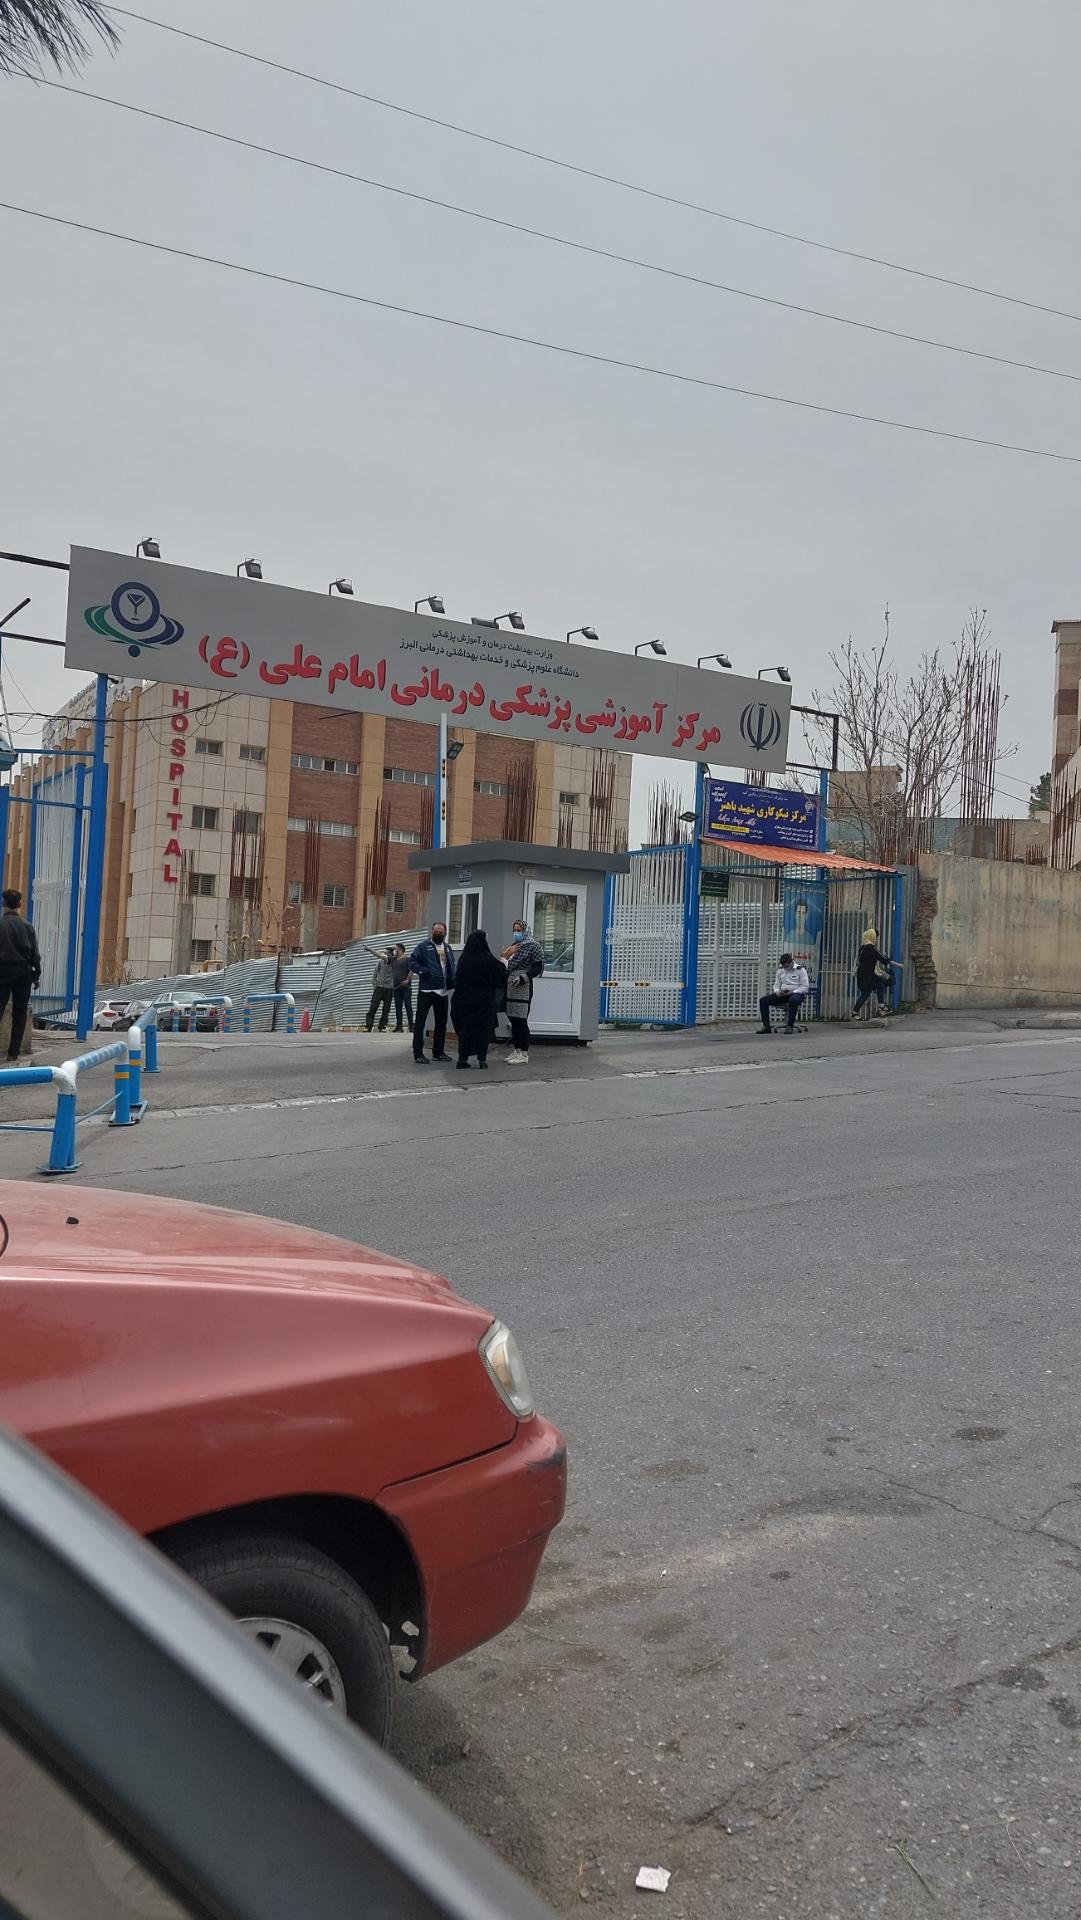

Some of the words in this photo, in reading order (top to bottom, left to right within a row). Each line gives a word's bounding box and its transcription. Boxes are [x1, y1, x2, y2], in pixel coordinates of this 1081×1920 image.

[432, 629, 456, 642] پزشکی
[457, 635, 481, 645] آموزش
[399, 638, 418, 649] البرز
[419, 643, 445, 654] درمانی
[487, 639, 507, 650] درمان
[508, 643, 534, 656] بهداشت
[199, 634, 250, 678] (ع)
[447, 649, 478, 662] بهداشتی
[479, 653, 503, 664] خدمات
[534, 648, 553, 660] وزارت
[259, 644, 322, 685] علی
[510, 659, 535, 675] پزشکی
[535, 664, 551, 674] علوم
[328, 654, 386, 694] امام
[553, 666, 579, 678] دانشگاه
[390, 666, 485, 714] درمانی
[489, 685, 572, 732] پزشکی
[575, 698, 668, 741] آموزشی
[671, 713, 721, 751] مرکز
[163, 689, 190, 883] HOSPITAL
[756, 806, 789, 820] نیکوکاری
[790, 810, 807, 824] مرکز
